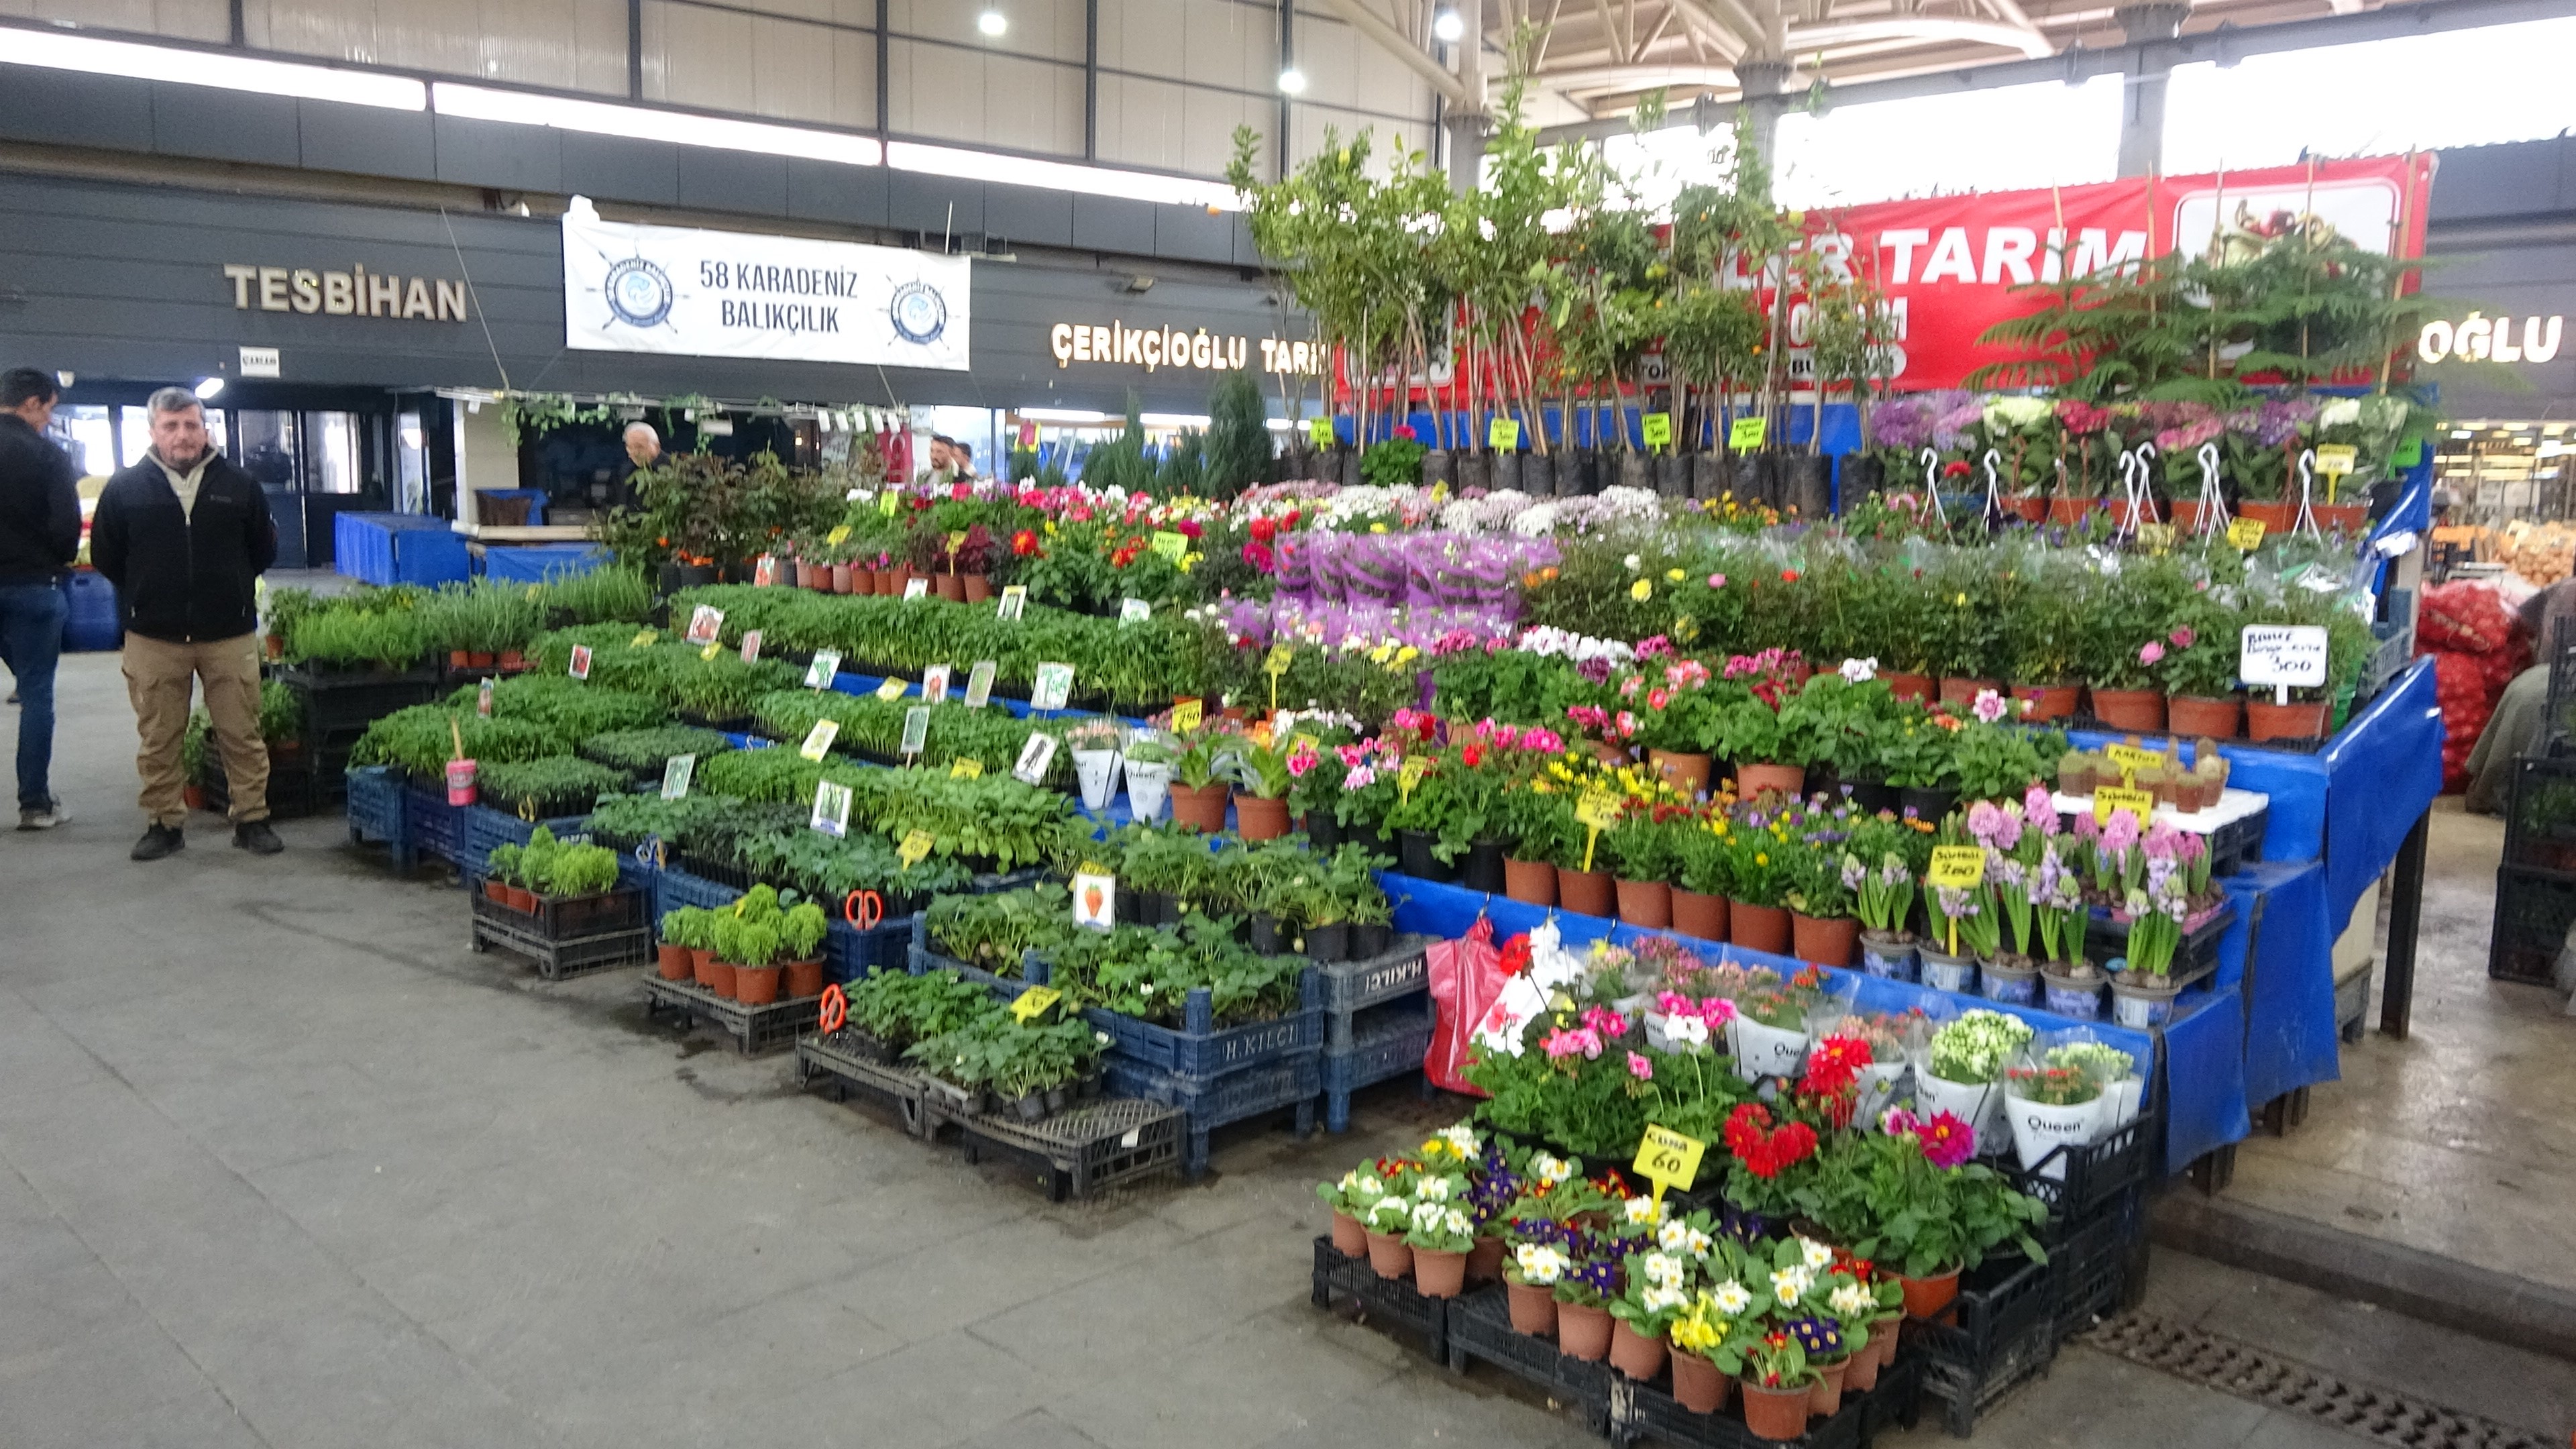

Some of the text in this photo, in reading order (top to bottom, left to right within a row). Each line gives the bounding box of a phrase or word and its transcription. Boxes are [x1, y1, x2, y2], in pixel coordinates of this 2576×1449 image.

[1880, 226, 2147, 288] TARIM
[223, 262, 467, 322] TESBİHAN
[700, 260, 729, 289] 58
[737, 262, 858, 299] KARADENİZ
[721, 299, 839, 336] BALIKÇILIK
[1052, 319, 1247, 373] ÇERİKÇİOĞLU
[2028, 1114, 2081, 1133] Queen
[1652, 1149, 1681, 1174] 60
